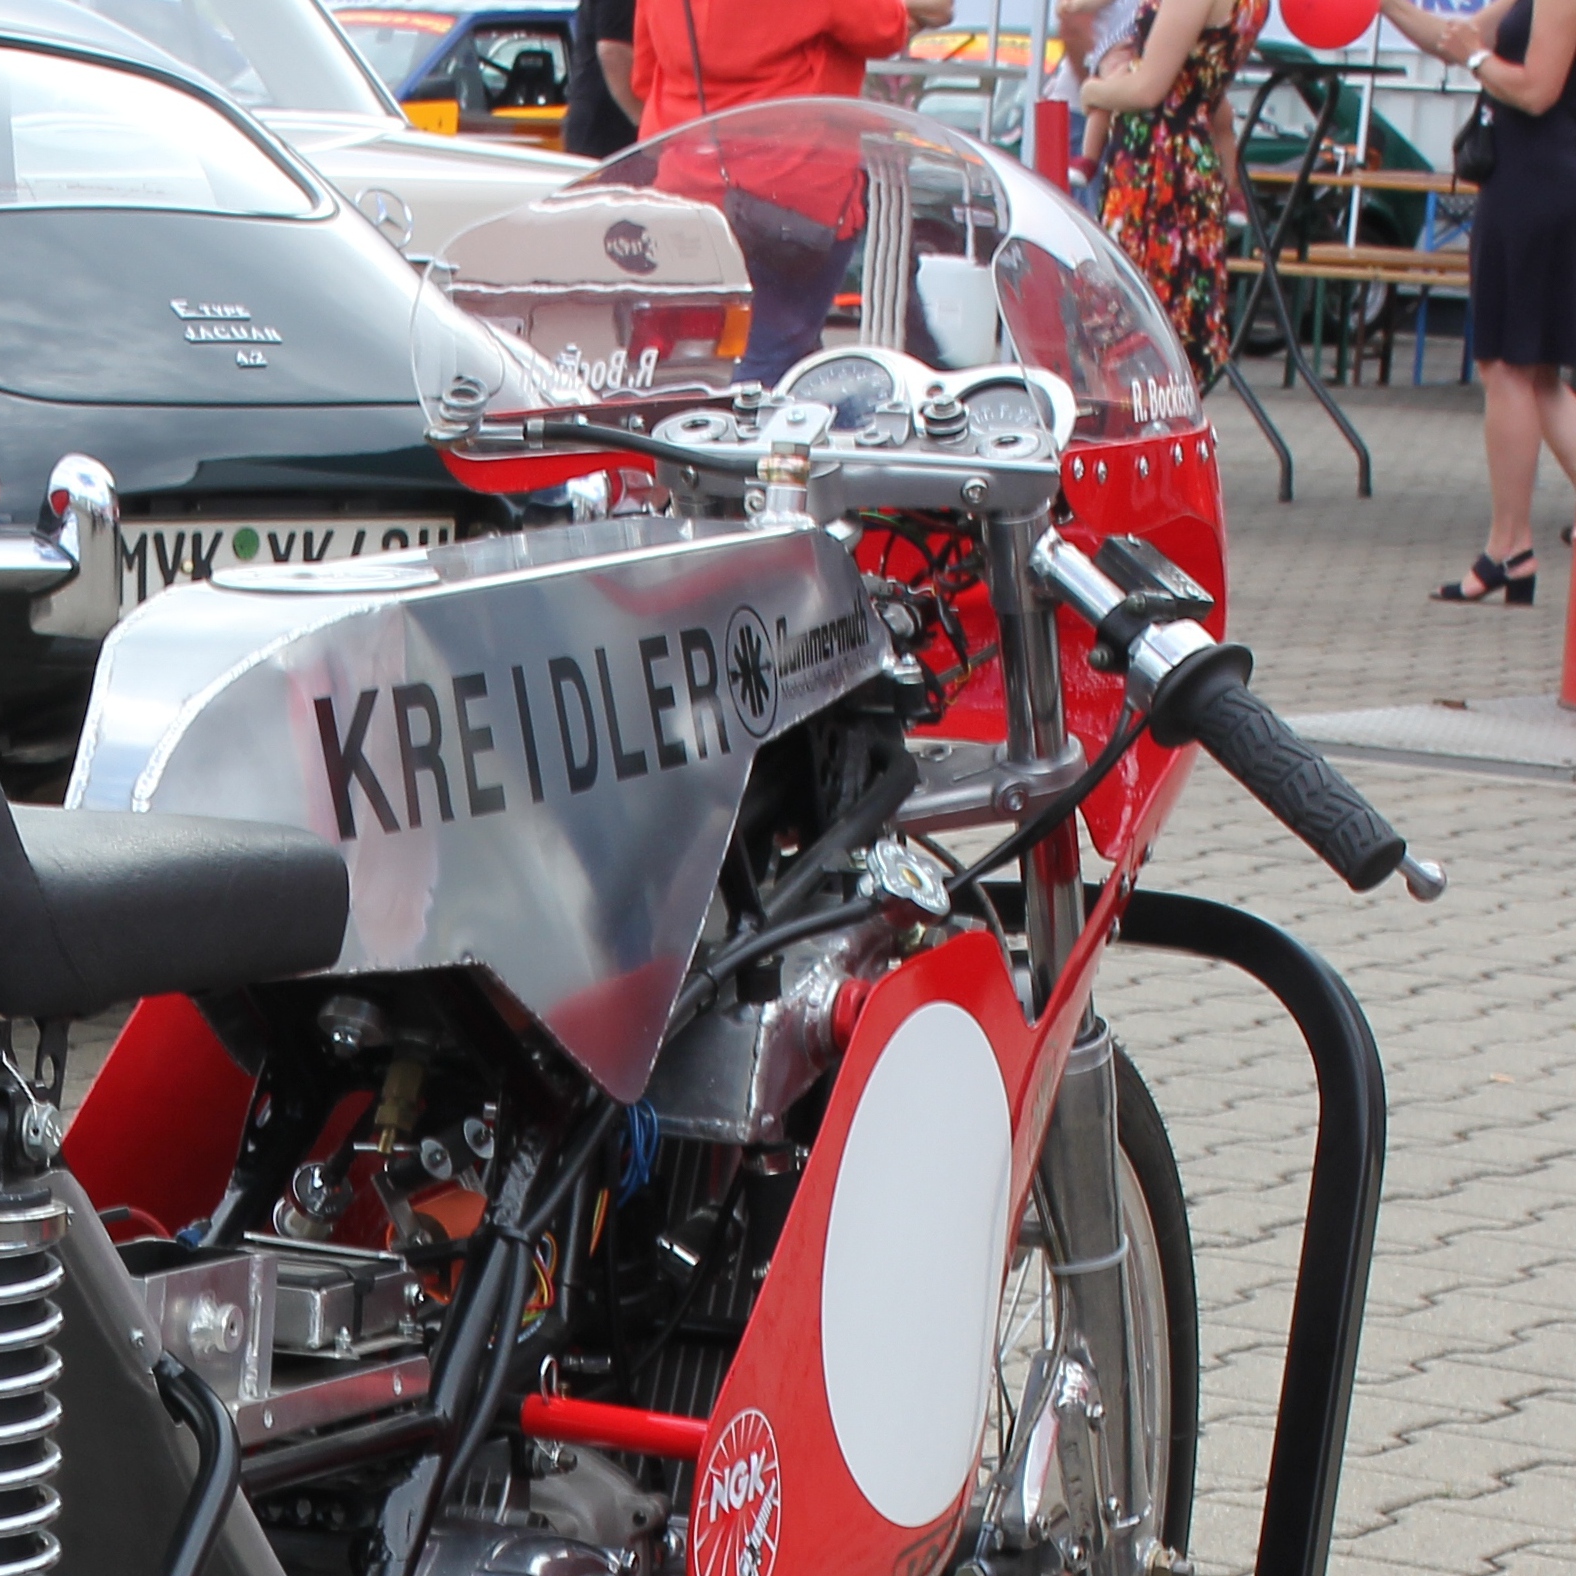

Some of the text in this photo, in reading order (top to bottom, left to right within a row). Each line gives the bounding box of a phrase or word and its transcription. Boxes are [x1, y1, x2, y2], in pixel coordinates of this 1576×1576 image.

[184, 324, 283, 343] JAGUAR
[313, 625, 731, 842] KREIDLER
[710, 1447, 766, 1523] NGK
